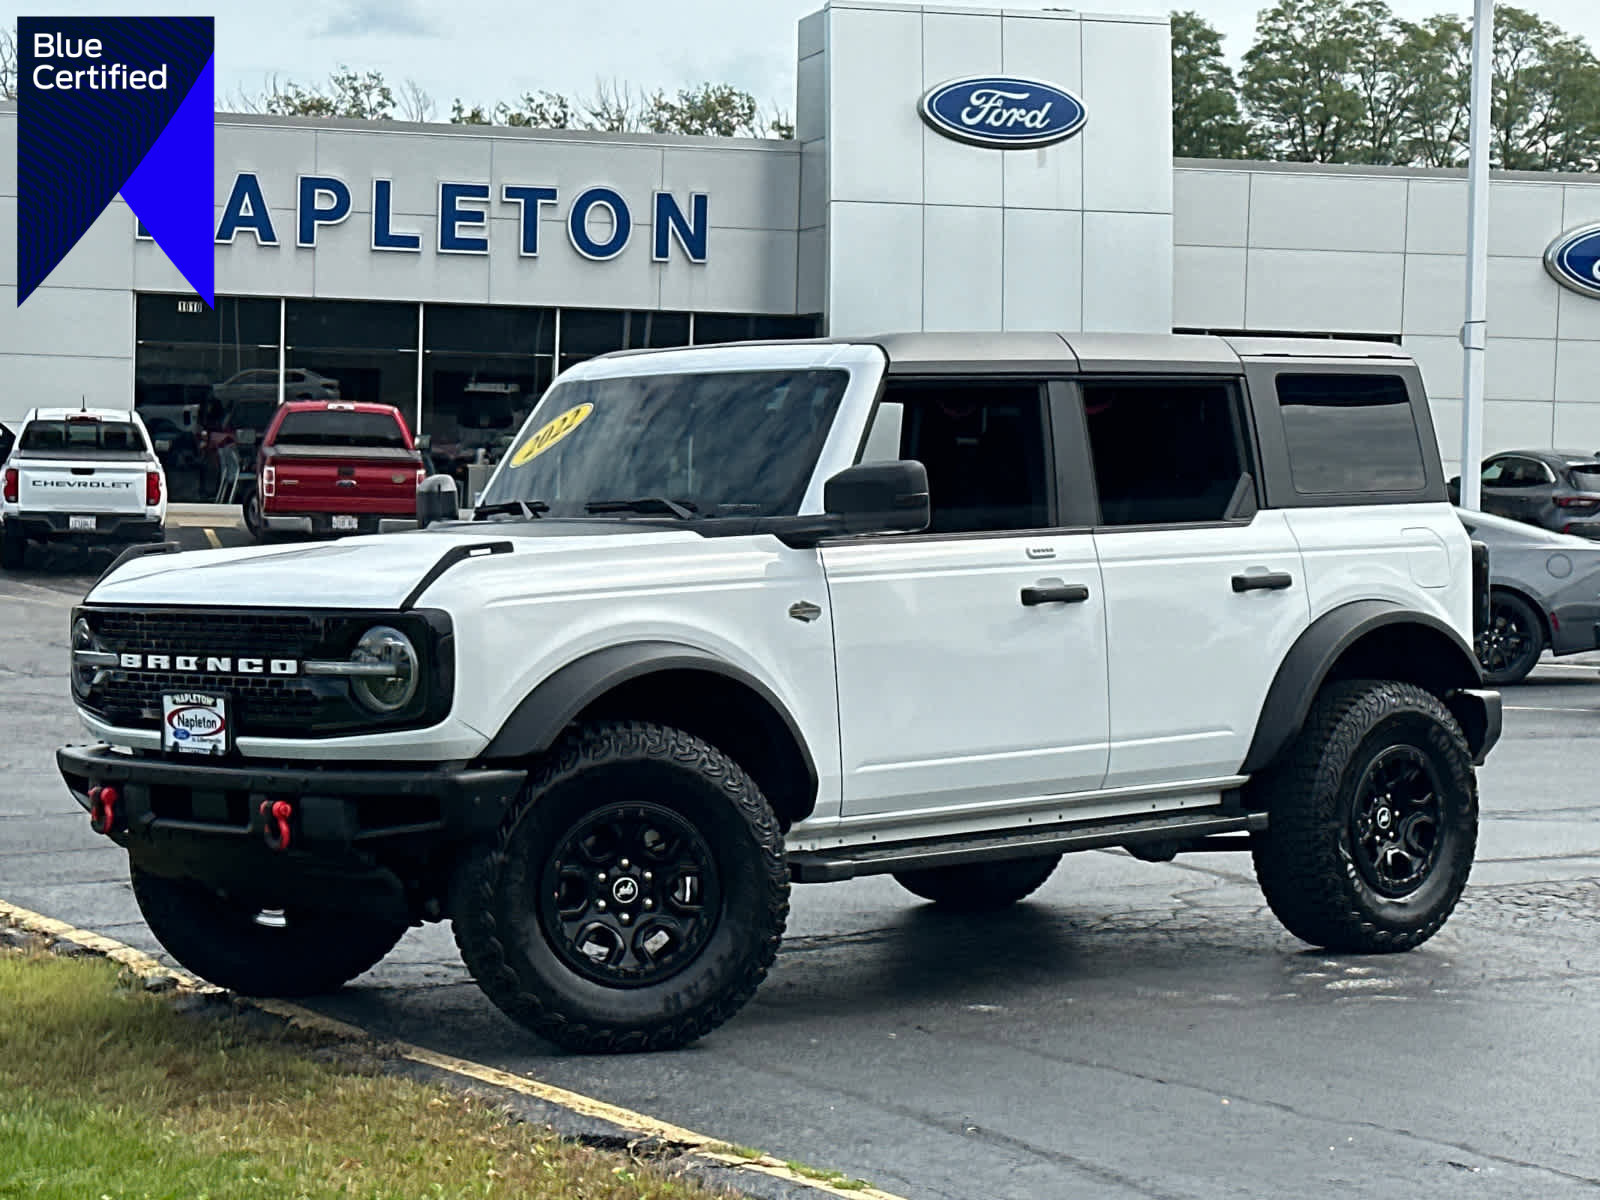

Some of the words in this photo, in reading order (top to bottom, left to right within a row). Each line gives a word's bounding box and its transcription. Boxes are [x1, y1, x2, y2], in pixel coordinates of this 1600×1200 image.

[961, 89, 1053, 129] Ford
[136, 171, 709, 263] APLETON
[522, 408, 581, 460] 2022
[32, 480, 133, 489] CHEVROLET
[120, 653, 298, 674] BRONCO
[177, 711, 217, 731] Napleton
